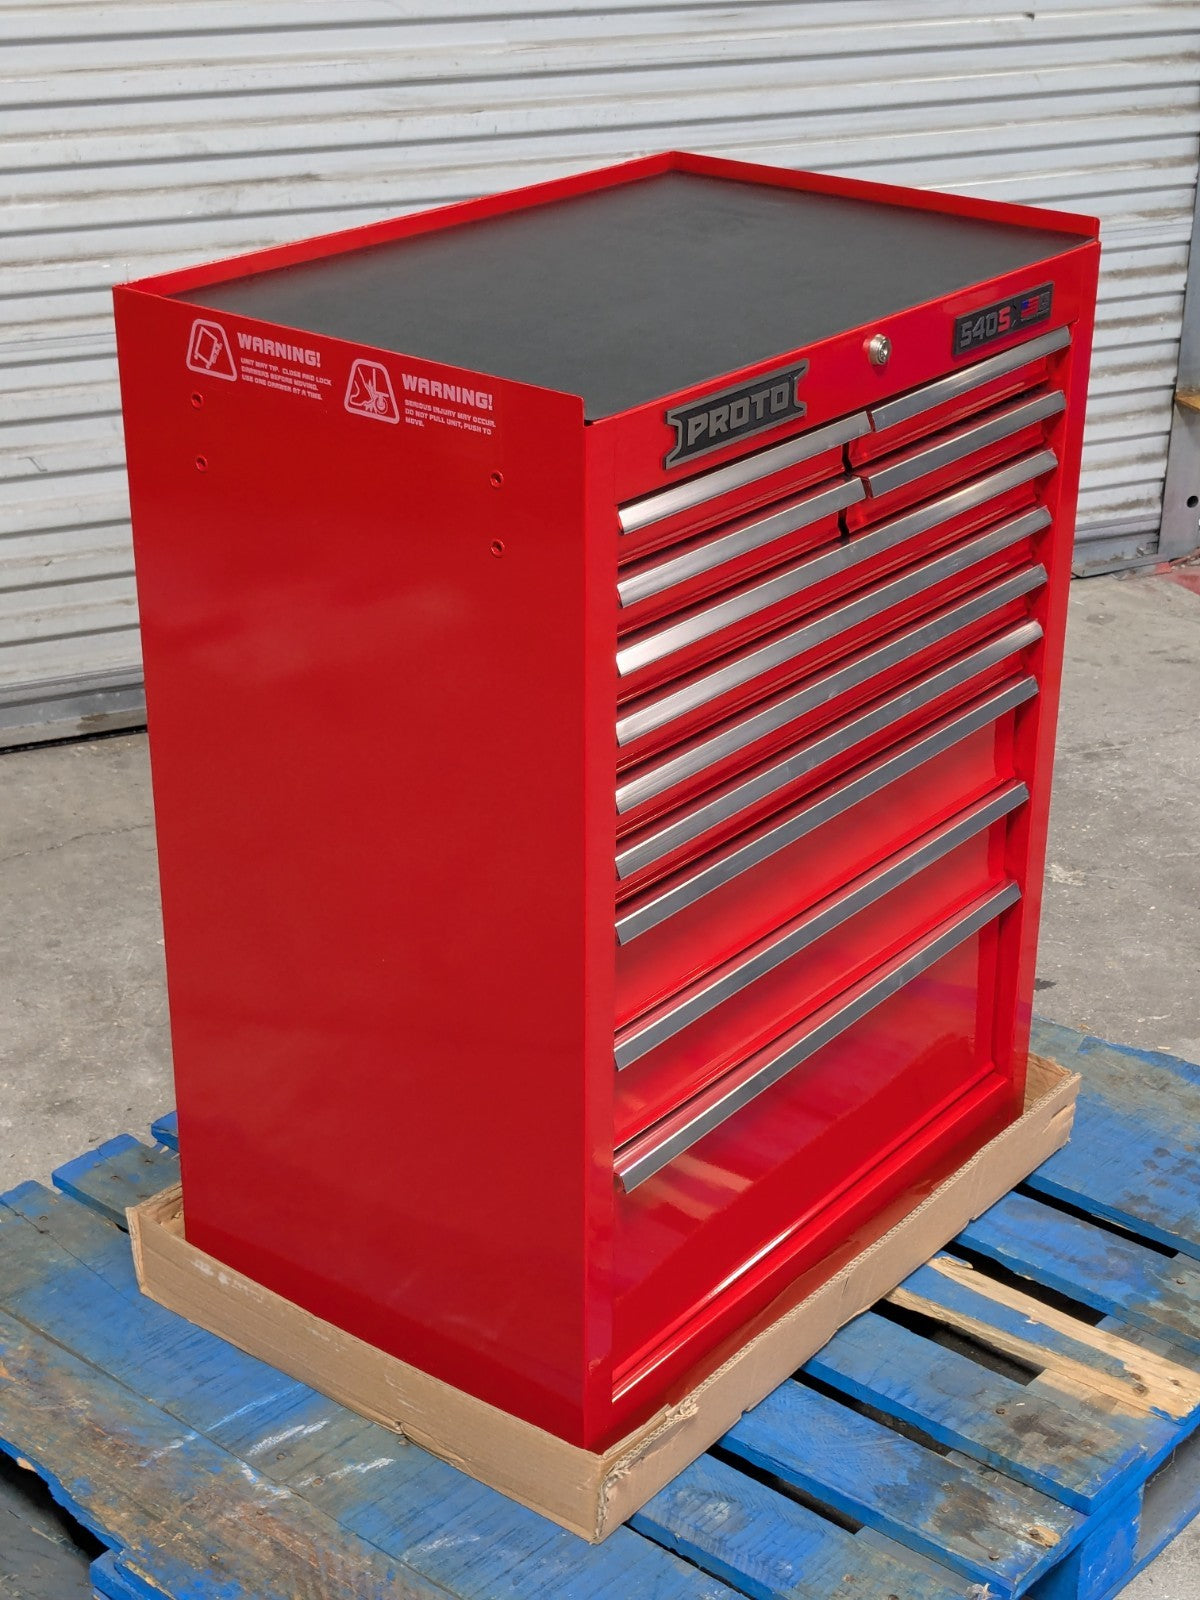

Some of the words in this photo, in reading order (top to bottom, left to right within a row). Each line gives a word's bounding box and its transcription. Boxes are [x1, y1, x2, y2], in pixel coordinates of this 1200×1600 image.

[237, 332, 321, 368] WARNING!
[254, 377, 267, 386] ONE
[293, 387, 301, 395] AT
[269, 364, 280, 373] TIP.
[282, 368, 301, 378] CLOSE
[302, 373, 315, 382] AND
[316, 376, 332, 386] LOCK
[270, 373, 293, 385] BEFORE
[401, 373, 493, 411] WARNING!
[405, 408, 414, 416] DO
[415, 411, 428, 419] NOT
[429, 414, 446, 424] PULL
[463, 423, 482, 433] PUSH
[482, 428, 492, 436] TO
[433, 406, 456, 417] INJURY
[457, 413, 472, 421] MAY
[687, 382, 790, 447] PROTO
